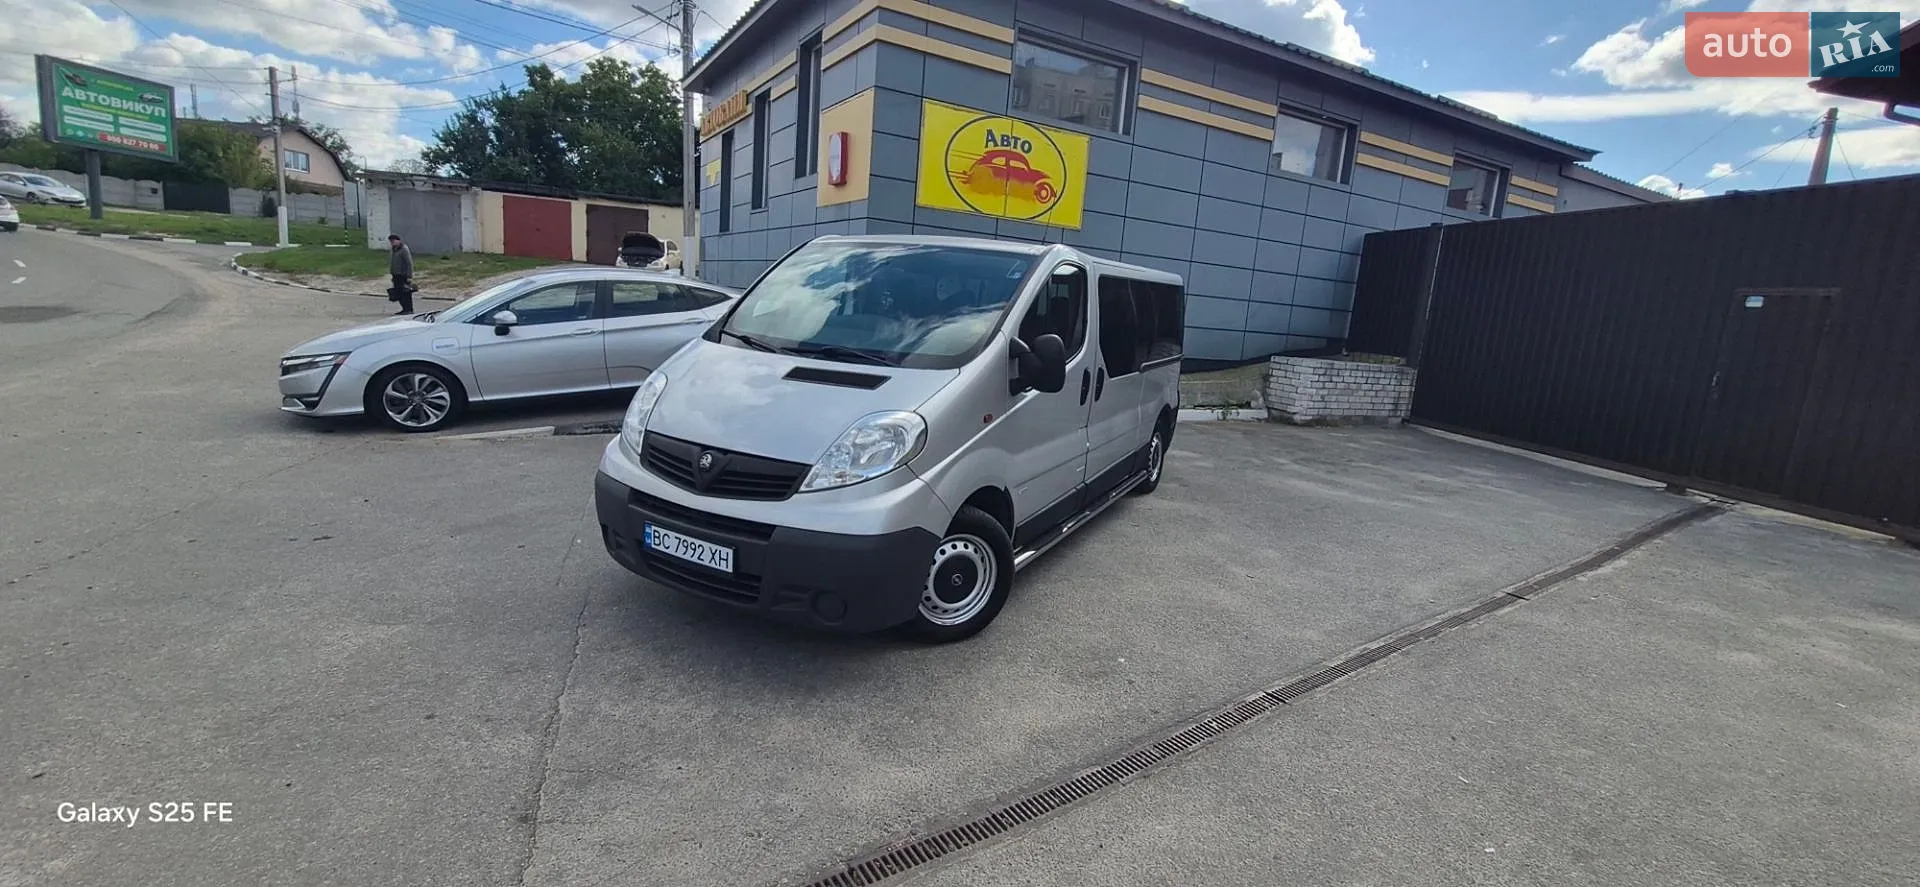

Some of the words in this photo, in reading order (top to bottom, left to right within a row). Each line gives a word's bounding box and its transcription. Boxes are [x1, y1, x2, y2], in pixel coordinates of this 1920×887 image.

[61, 86, 166, 118] АВТОВИКУП
[652, 529, 671, 550] BC
[674, 536, 706, 562] 7992
[708, 546, 729, 569] XH
